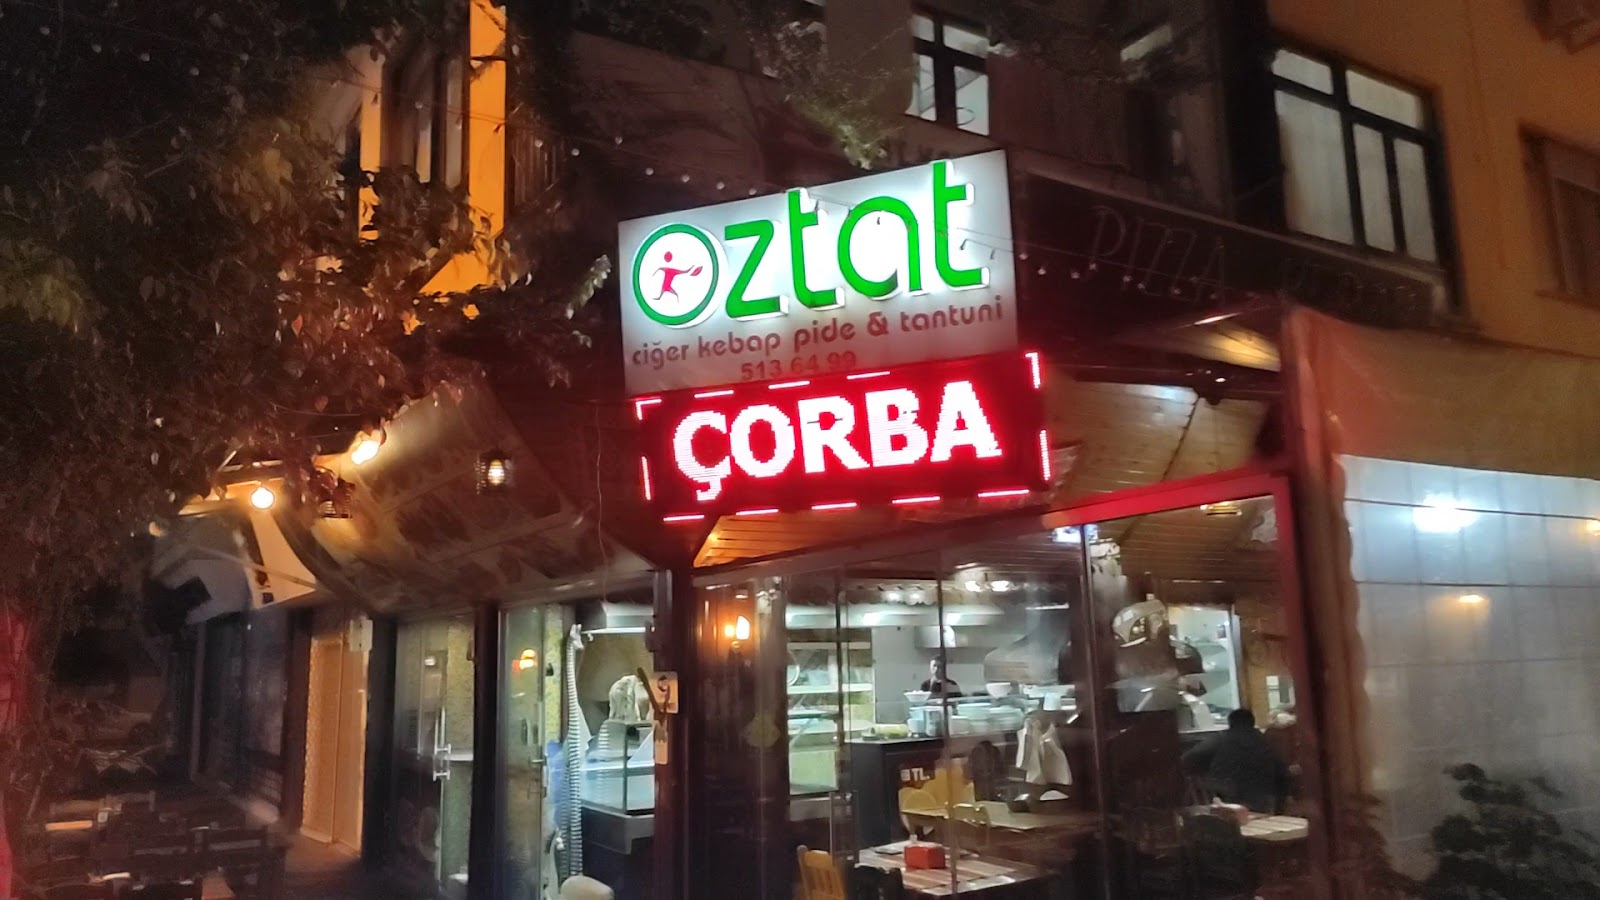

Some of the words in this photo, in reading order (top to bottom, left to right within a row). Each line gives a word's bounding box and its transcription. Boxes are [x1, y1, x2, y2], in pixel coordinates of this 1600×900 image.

[632, 338, 690, 371] ciğer
[697, 331, 782, 360] kebap
[793, 314, 857, 353] pide
[866, 310, 890, 337] &
[900, 295, 1004, 334] tantuni
[740, 358, 784, 382] 513
[790, 353, 819, 375] 64
[671, 380, 1002, 502] ÇORBA
